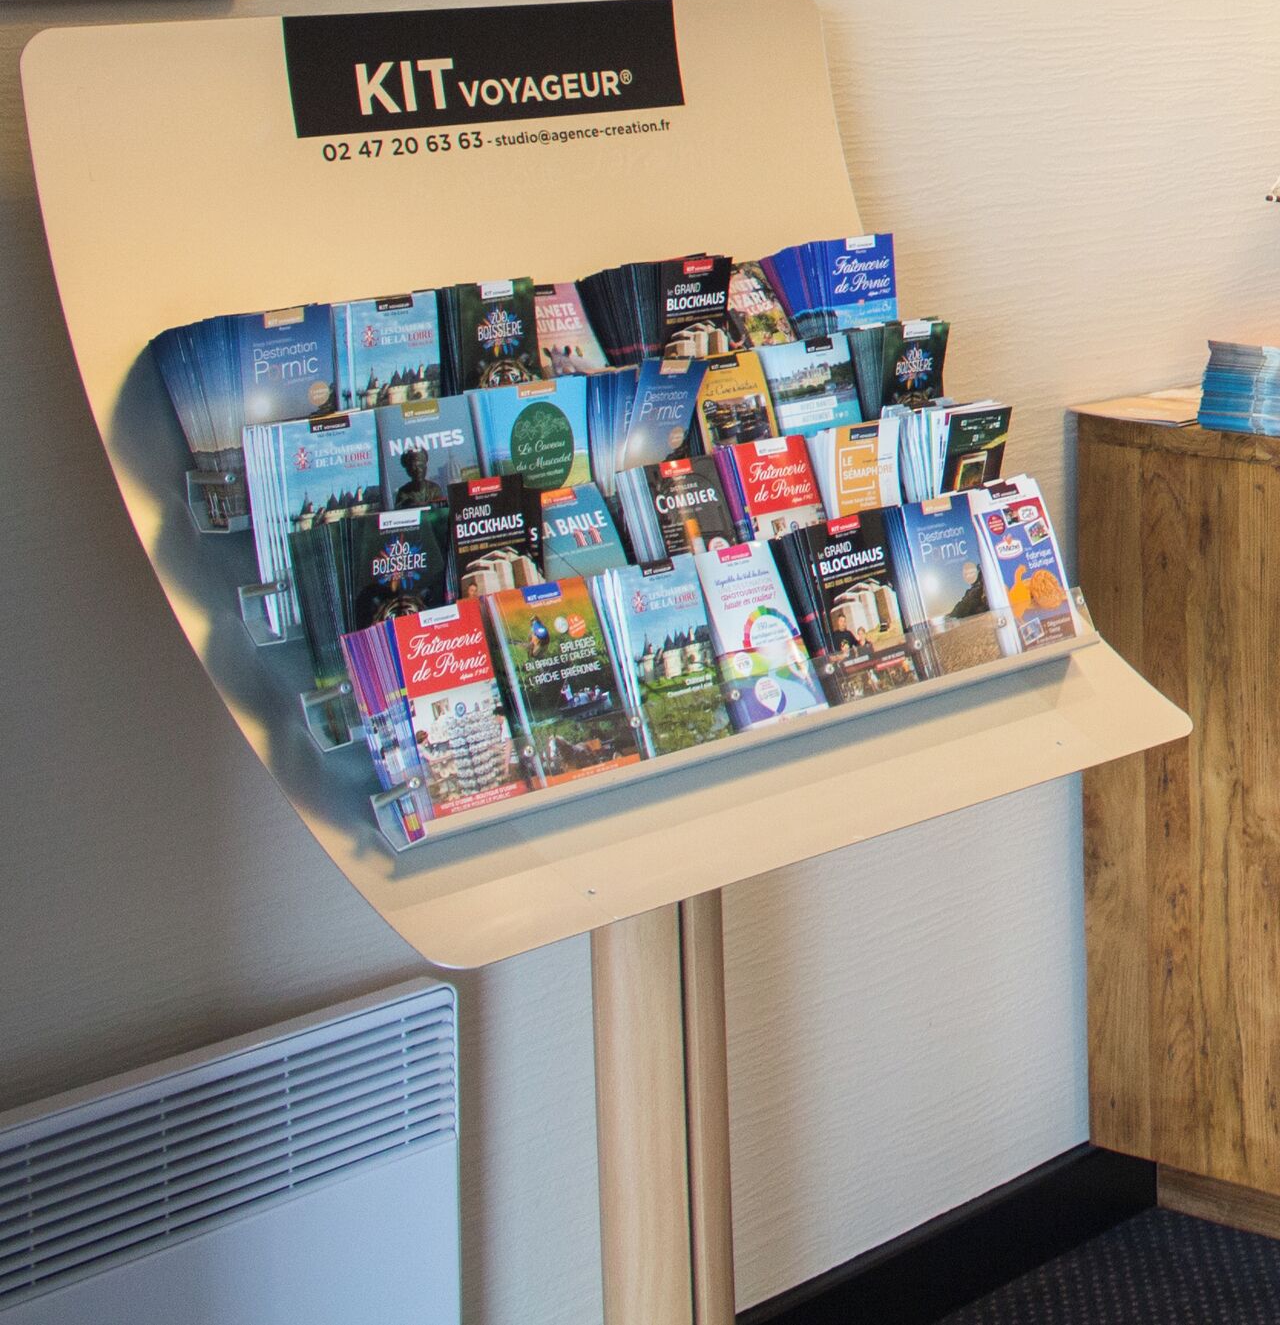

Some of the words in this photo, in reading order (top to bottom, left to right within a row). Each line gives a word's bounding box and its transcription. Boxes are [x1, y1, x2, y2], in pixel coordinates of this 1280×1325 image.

[355, 57, 456, 116] KIT
[322, 141, 352, 162] 02
[359, 139, 384, 160] 47
[392, 136, 419, 157] 20
[426, 133, 452, 153] 63
[458, 131, 484, 151] 63
[674, 281, 702, 296] GRAND
[834, 279, 850, 295] de
[848, 273, 891, 294] Pornic
[665, 291, 725, 312] BLOCKHAUS
[408, 330, 433, 341] LOIRE
[252, 340, 318, 361] Destination
[254, 355, 319, 384] Pornic
[643, 390, 689, 403] Destination
[388, 428, 465, 456] NANTES
[517, 442, 532, 456] Le
[344, 451, 373, 463] LOIRE
[516, 460, 527, 472] du
[529, 452, 572, 471] Muscadet
[842, 455, 853, 467] LE
[656, 487, 718, 515] COMBIER
[754, 484, 769, 503] de
[769, 478, 812, 501] Pornic
[462, 504, 491, 520] GRAND
[456, 513, 524, 539] BLOCKHAUS
[555, 510, 608, 536] BAULE
[917, 524, 966, 546] Destination
[823, 541, 852, 557] GRAND
[920, 538, 968, 564] Pornic
[372, 552, 427, 576] BOISSIÈRE
[819, 546, 884, 577] BLOCKHAUS
[673, 593, 698, 605] LOIRE
[560, 636, 596, 653] BALADES
[412, 662, 431, 684] de
[433, 650, 487, 679] Pornic
[525, 662, 535, 672] EN
[560, 653, 569, 663] ET
